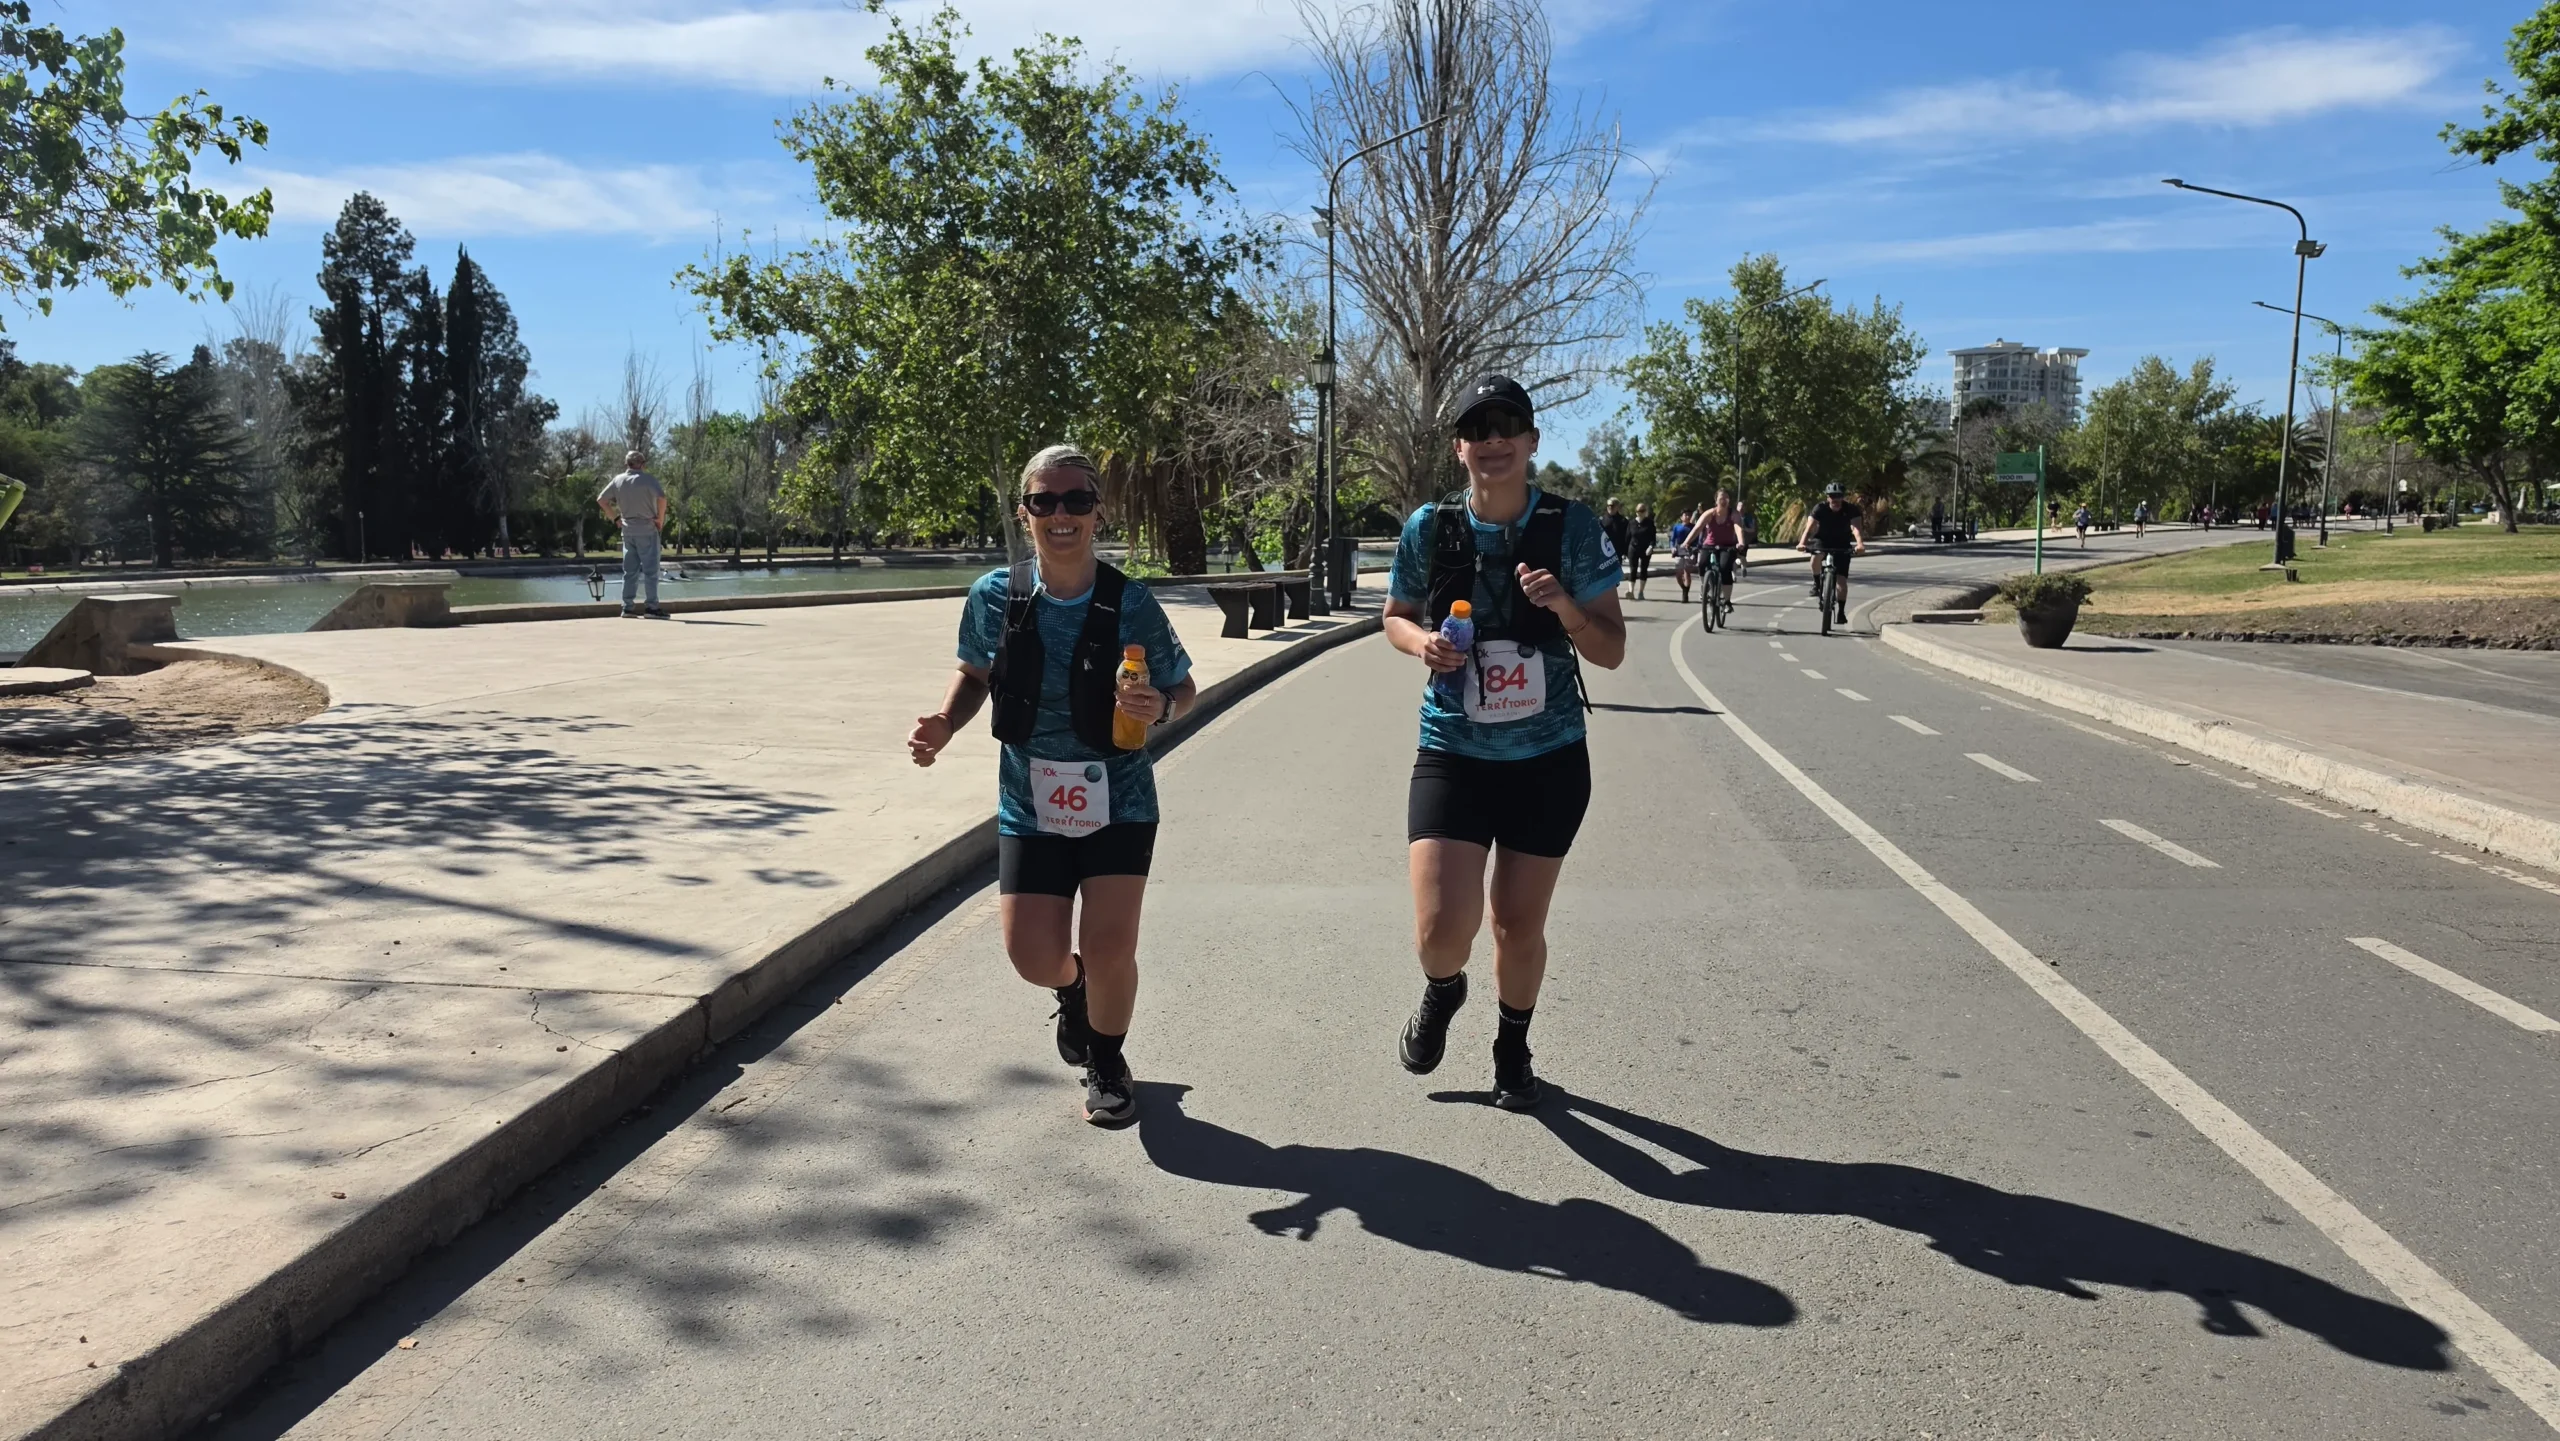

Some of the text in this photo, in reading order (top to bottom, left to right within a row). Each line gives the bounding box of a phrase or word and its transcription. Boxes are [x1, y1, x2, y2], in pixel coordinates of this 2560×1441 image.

[1042, 767, 1058, 777] 10k
[1048, 785, 1088, 812] 46
[1045, 815, 1102, 828] TERRITORIO
